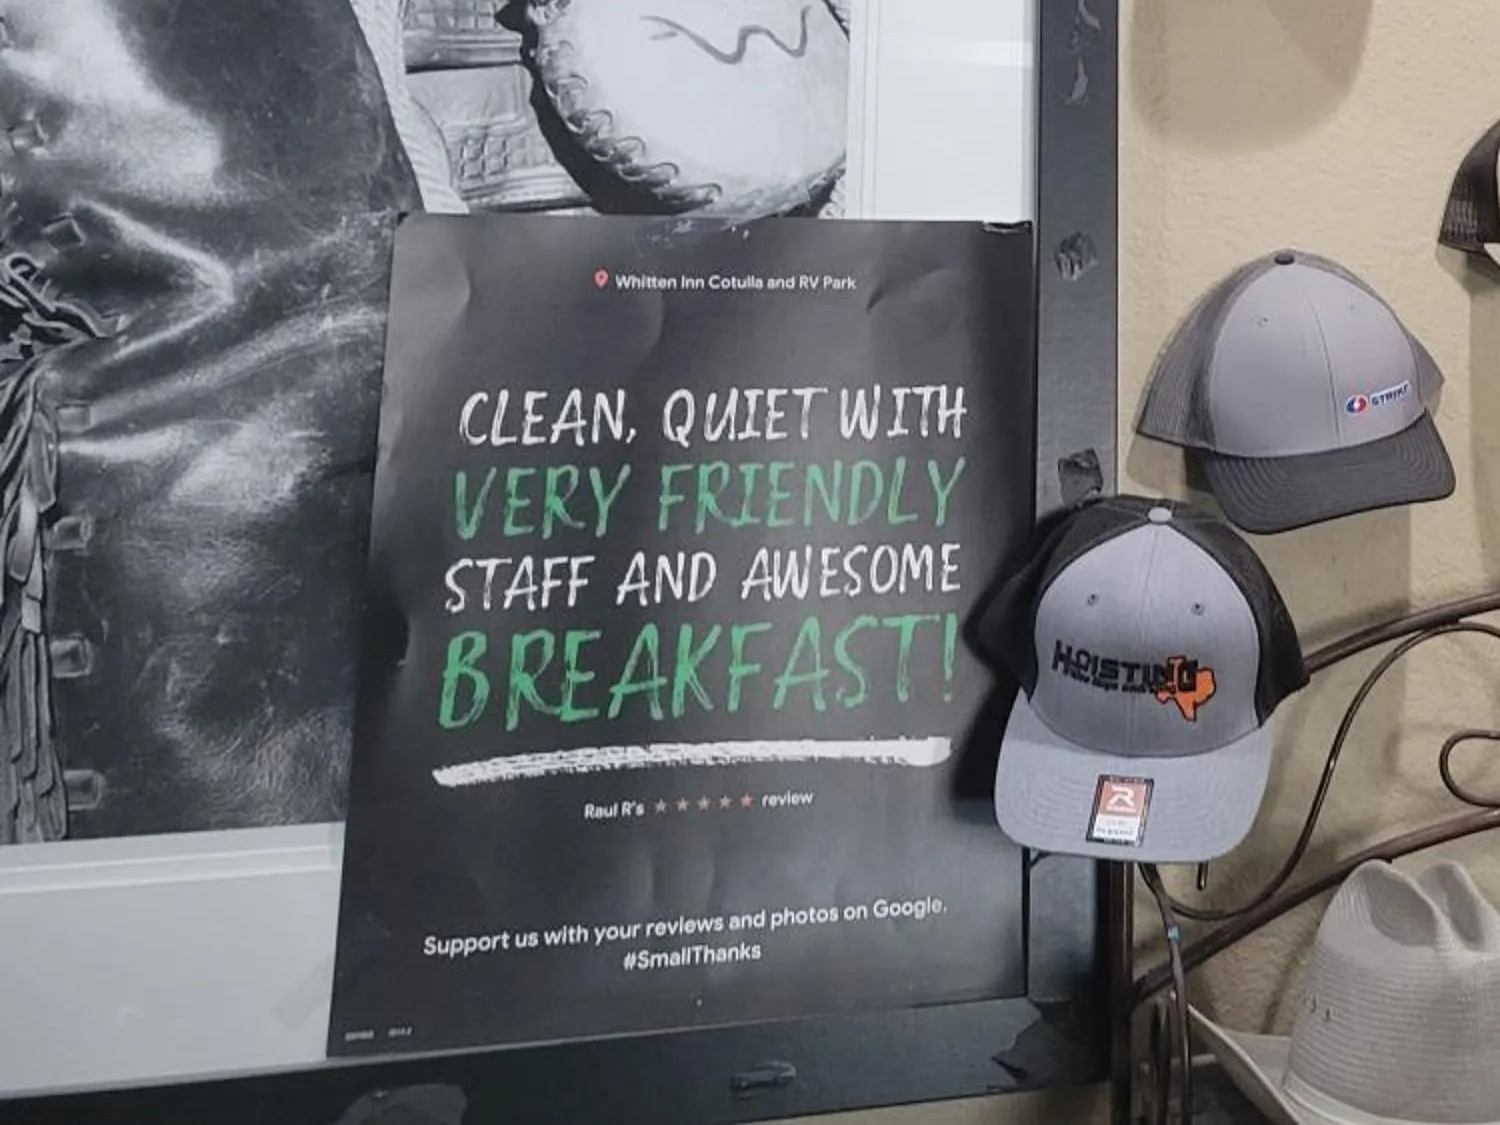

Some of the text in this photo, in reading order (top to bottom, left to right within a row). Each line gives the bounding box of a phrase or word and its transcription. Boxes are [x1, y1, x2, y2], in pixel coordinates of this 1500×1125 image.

[615, 274, 857, 290] Whitten Inn Cotulla and RV Park
[459, 384, 967, 448] CLEAN, QUIET WITH
[453, 457, 965, 539] VERY FRIENDLY
[445, 543, 961, 613] STAFF AND AWESOME
[438, 613, 958, 731] BREAKFAST!
[1052, 639, 1199, 692] HOISTING
[584, 790, 814, 820] Raul R's review
[423, 896, 947, 958] Support us with your reviews and photos on Google.
[623, 942, 762, 970] #SmallThanks
